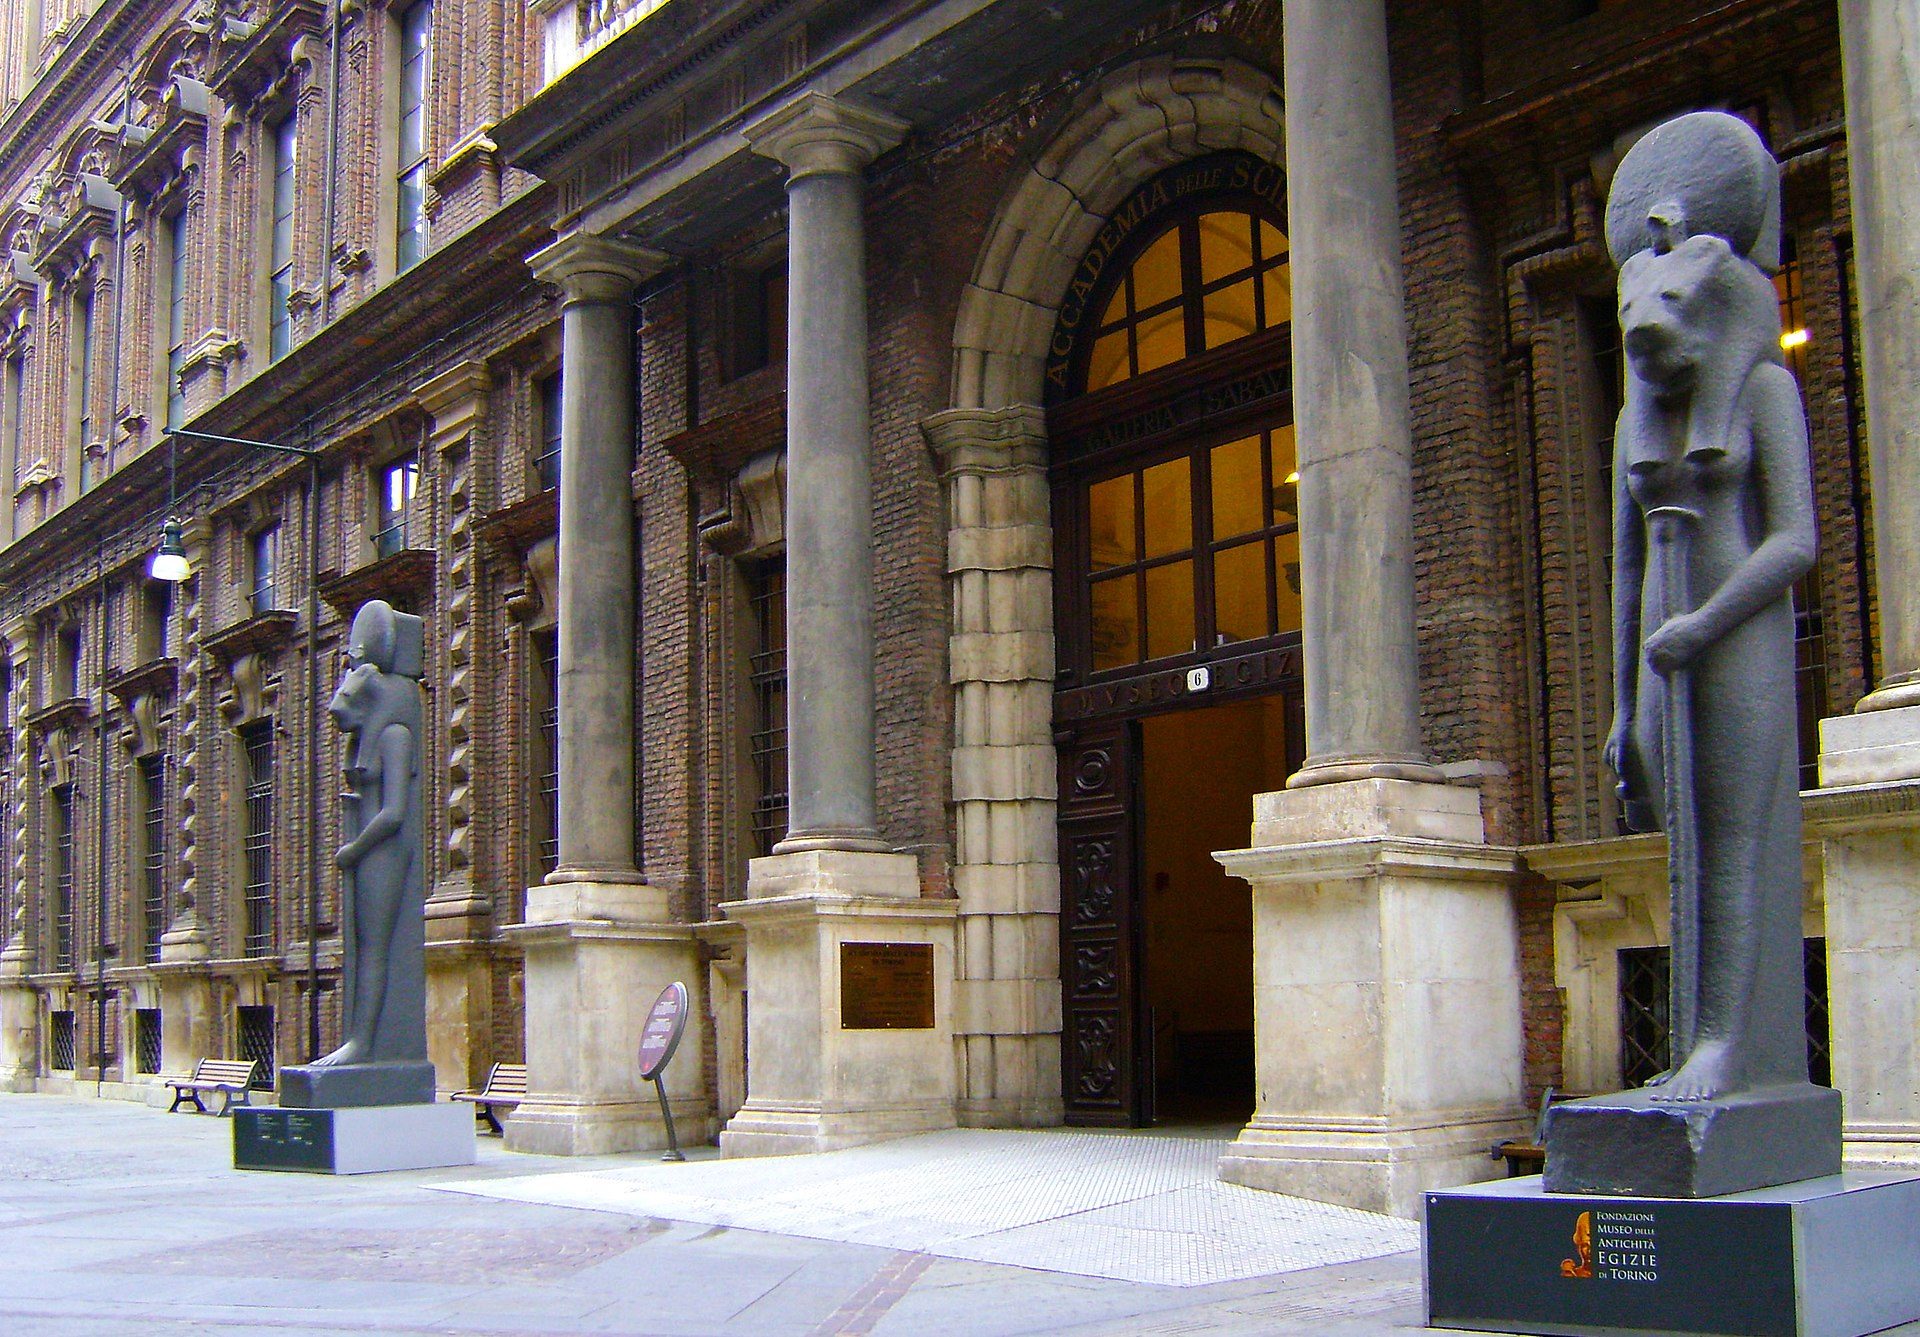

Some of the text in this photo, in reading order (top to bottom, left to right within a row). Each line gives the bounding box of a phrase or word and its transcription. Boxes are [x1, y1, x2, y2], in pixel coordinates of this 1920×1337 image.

[1047, 181, 1170, 390] ACCADEMIA
[1176, 168, 1224, 197] DELLE
[1208, 369, 1288, 413] SABAV
[1194, 672, 1202, 687] 6
[1596, 1211, 1655, 1222] FONDAZIONE
[1597, 1224, 1633, 1234] MUSEO
[1598, 1238, 1656, 1250] ANTICHITÀ
[1598, 1251, 1657, 1267] EGIZIE
[1598, 1268, 1657, 1281] DI TORINO
